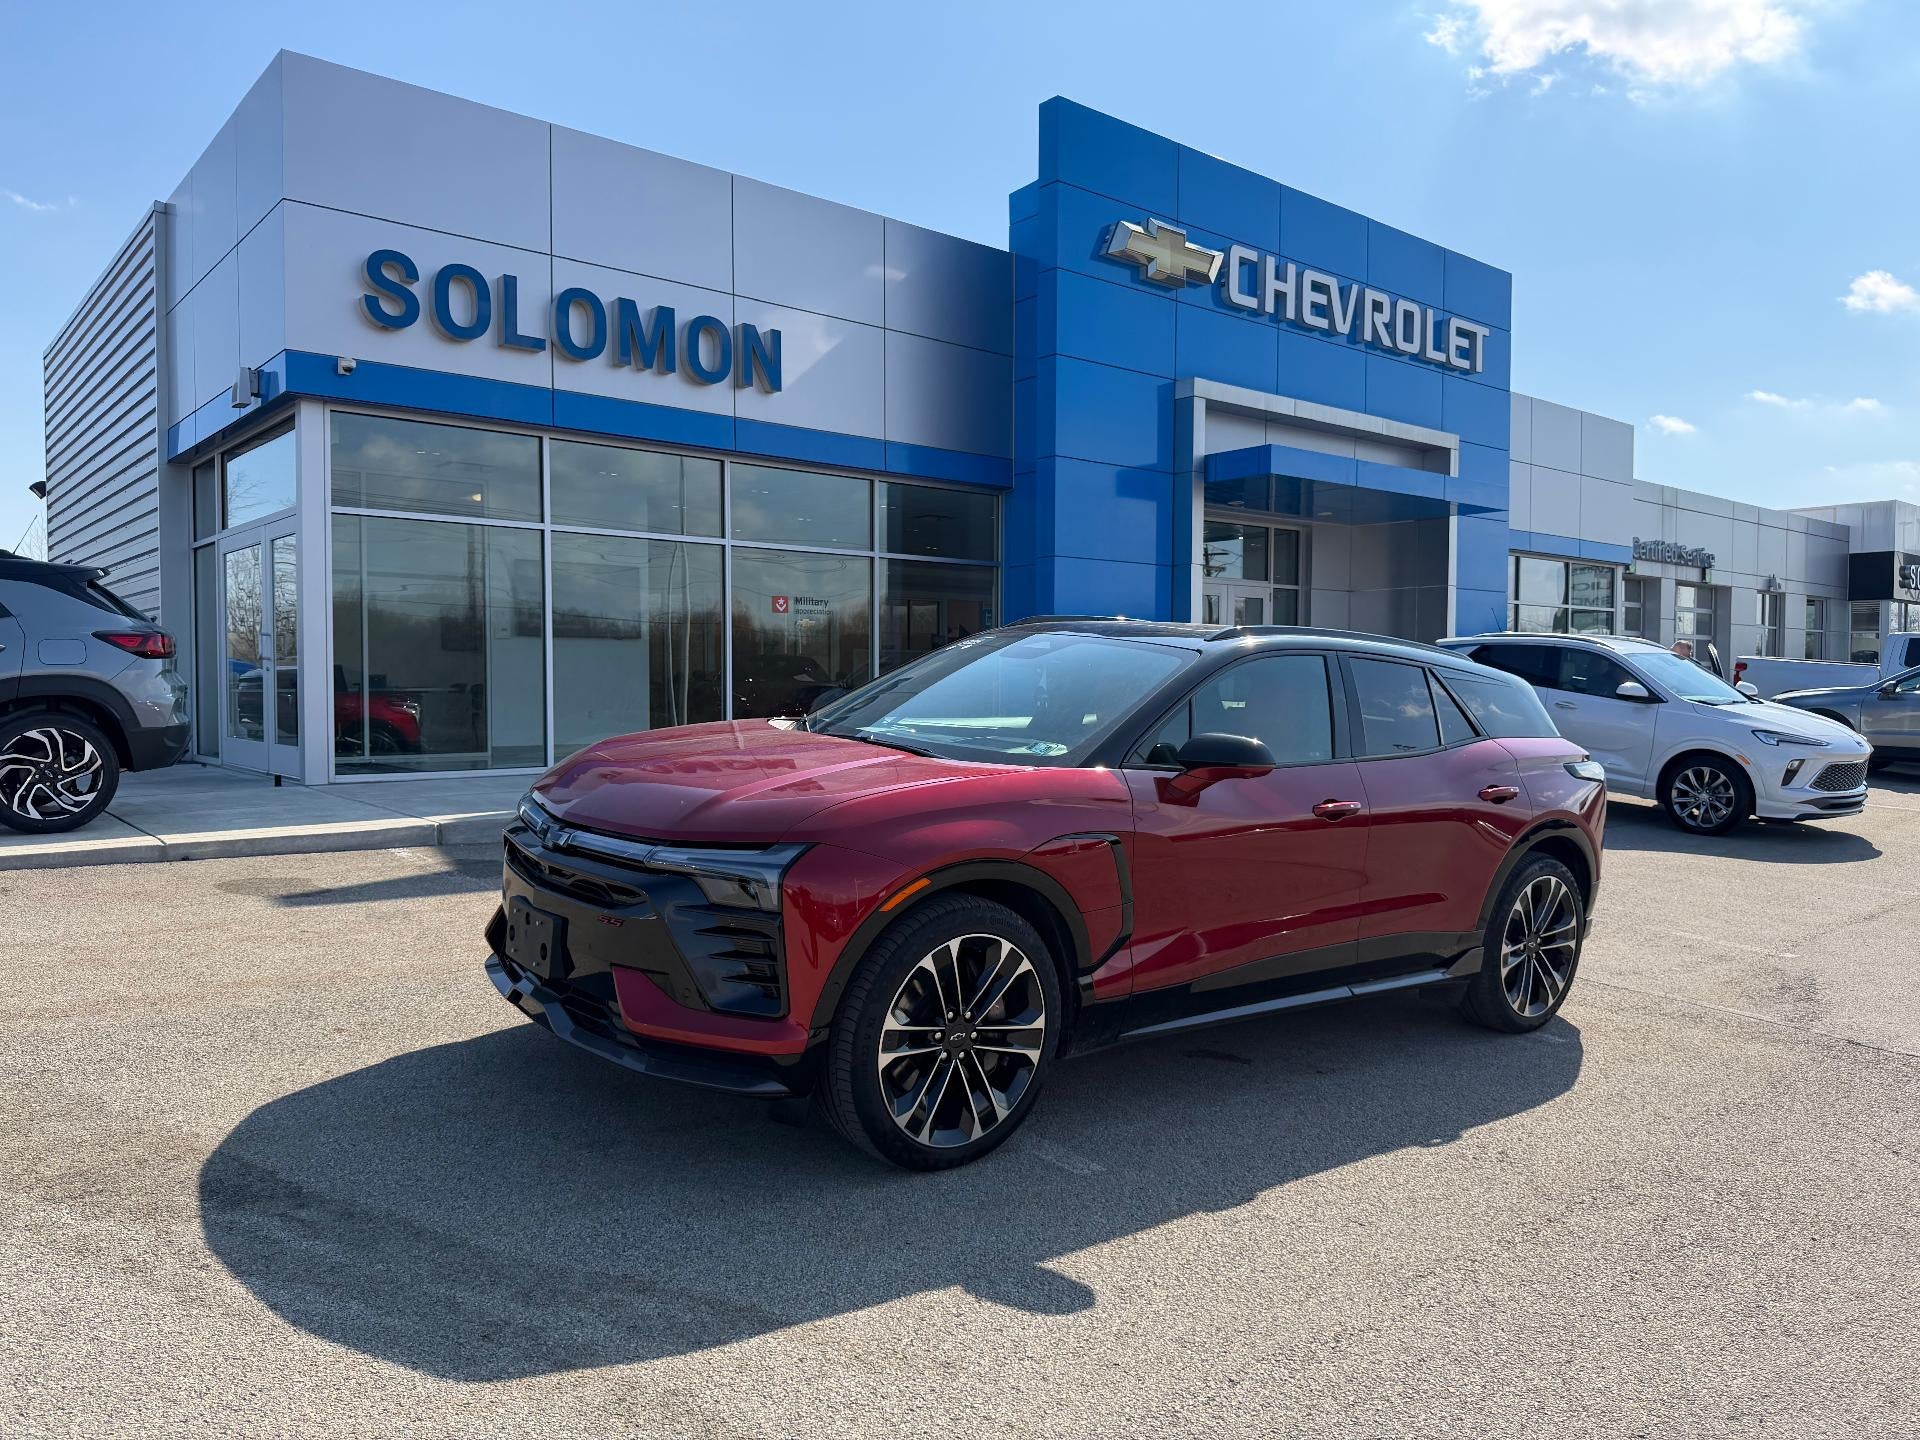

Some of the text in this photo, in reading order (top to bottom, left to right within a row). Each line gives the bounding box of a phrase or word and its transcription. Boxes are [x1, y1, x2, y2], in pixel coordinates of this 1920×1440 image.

[360, 249, 782, 394] SOLOMON
[1226, 244, 1490, 374] CHEVROLET
[1632, 536, 1716, 568] Certified Service
[794, 596, 829, 609] Military
